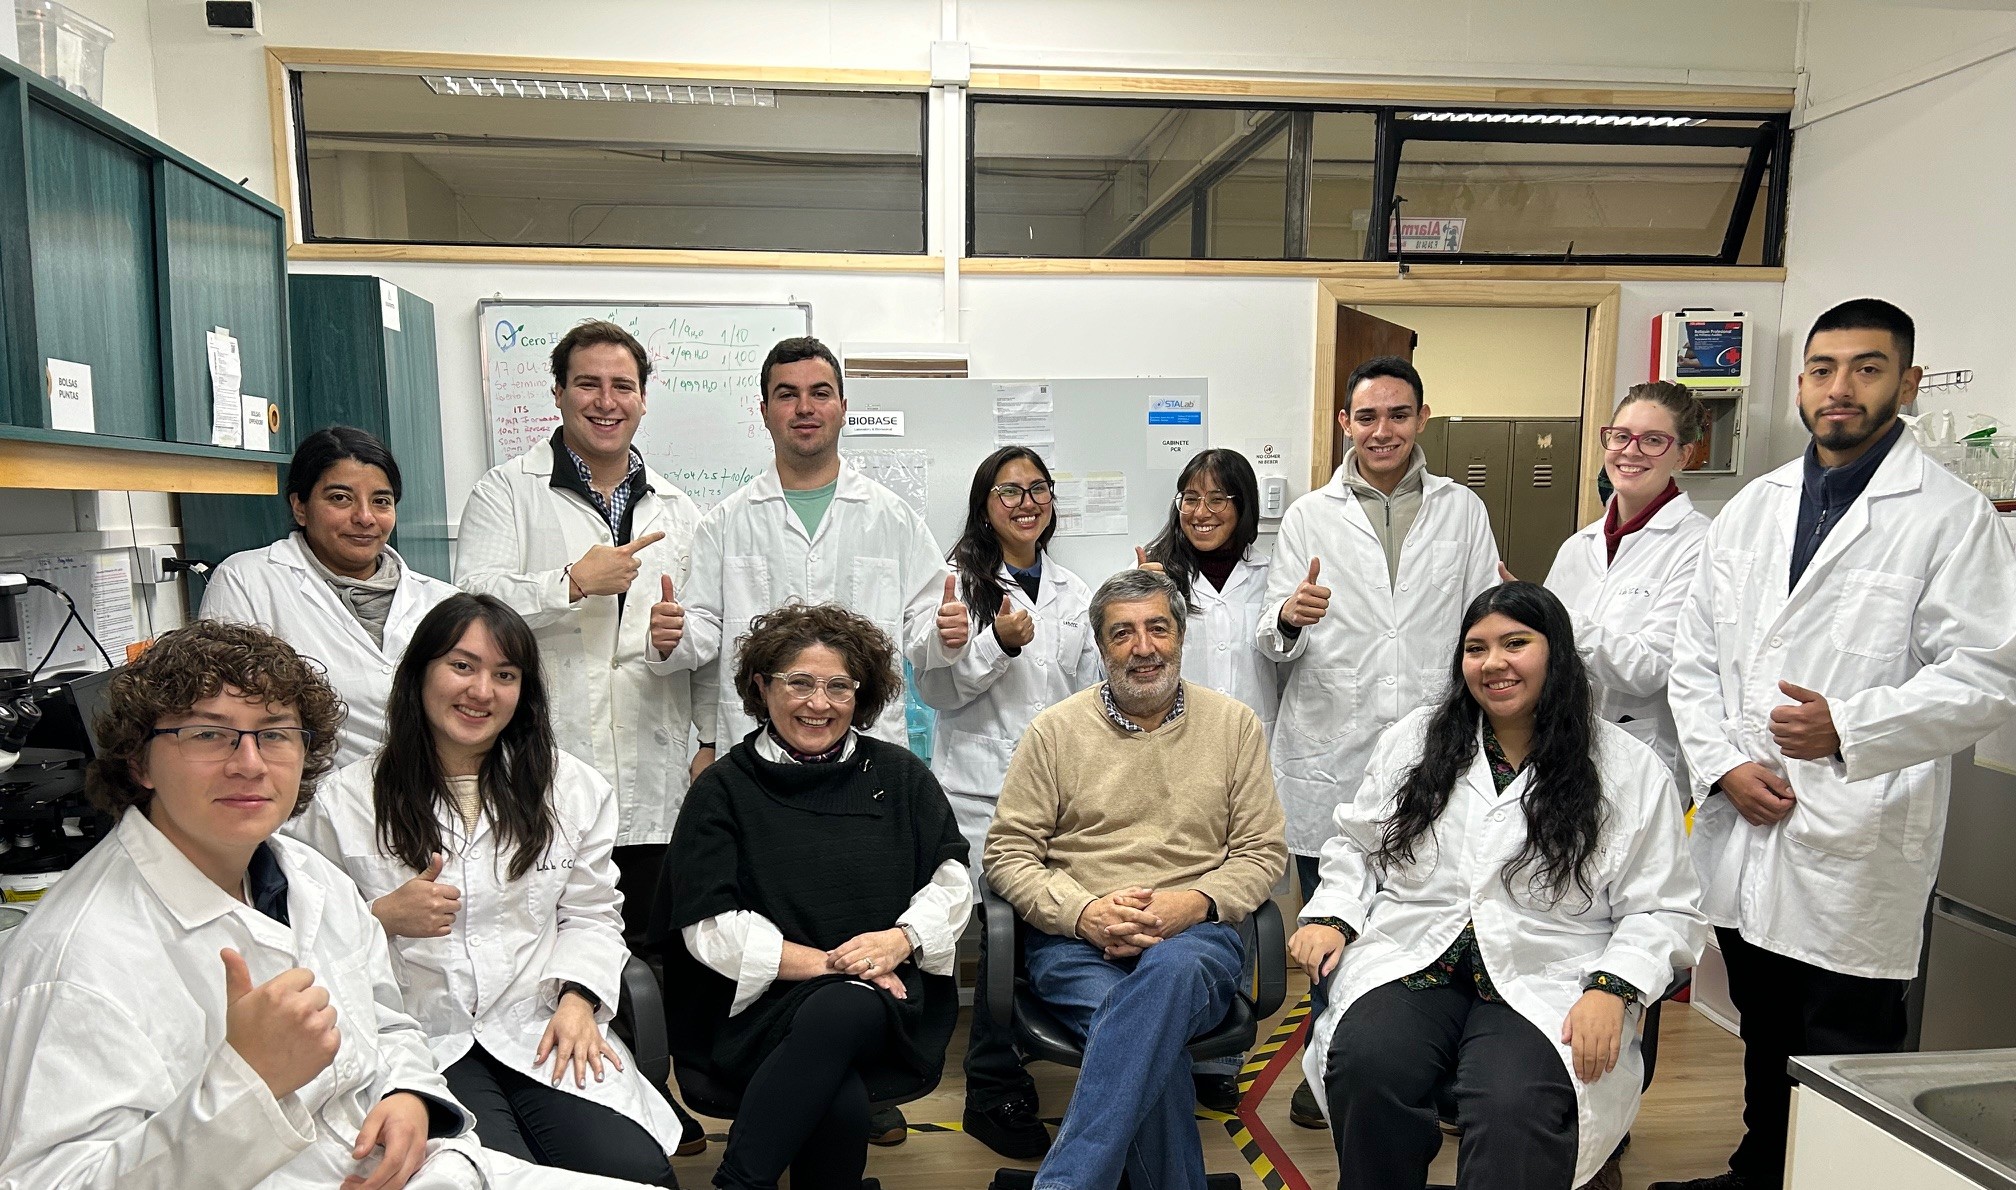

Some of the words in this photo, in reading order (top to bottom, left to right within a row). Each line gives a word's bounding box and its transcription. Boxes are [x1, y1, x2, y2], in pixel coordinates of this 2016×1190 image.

[521, 336, 546, 347] Cero
[58, 377, 78, 388] BOLSAS
[58, 389, 79, 400] PUNTAS
[513, 405, 529, 414] ITS
[1165, 400, 1194, 408] STALab
[848, 416, 898, 426] BIOBASE
[536, 859, 557, 872] Lab
